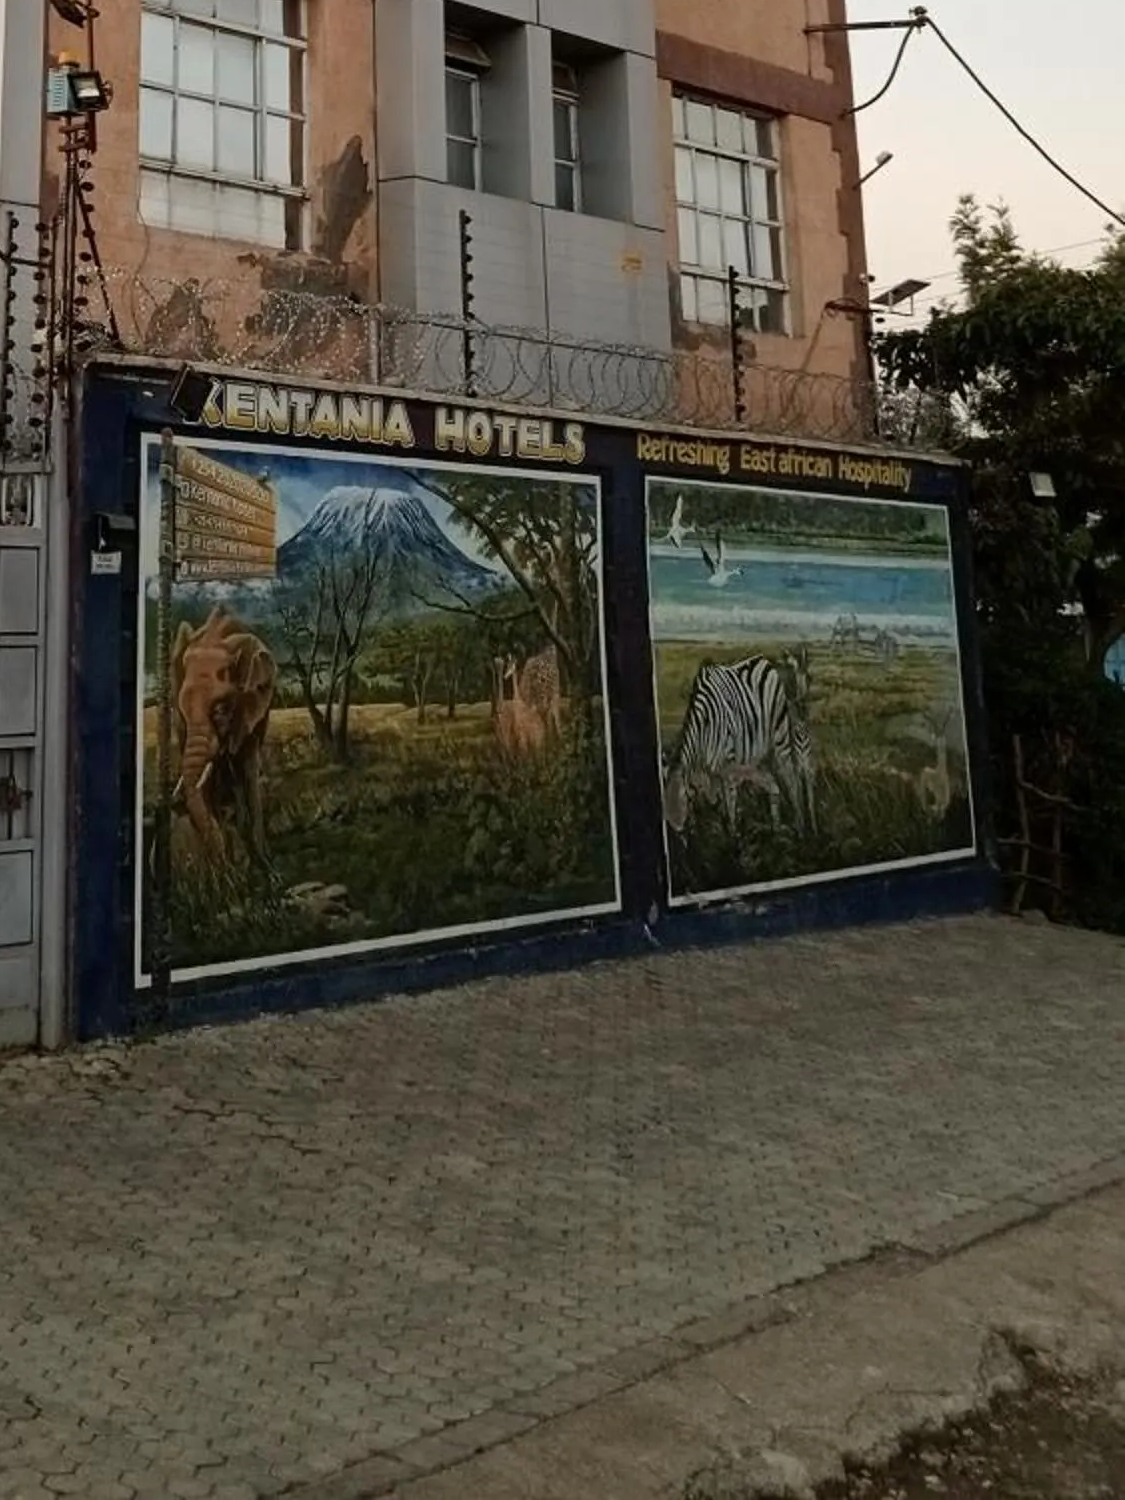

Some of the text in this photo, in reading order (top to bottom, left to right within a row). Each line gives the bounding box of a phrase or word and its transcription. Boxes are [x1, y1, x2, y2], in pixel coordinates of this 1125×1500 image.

[434, 404, 587, 466] HOTELS
[636, 432, 731, 476] Refreshing
[739, 446, 776, 474] East
[837, 454, 913, 493] Hospitality
